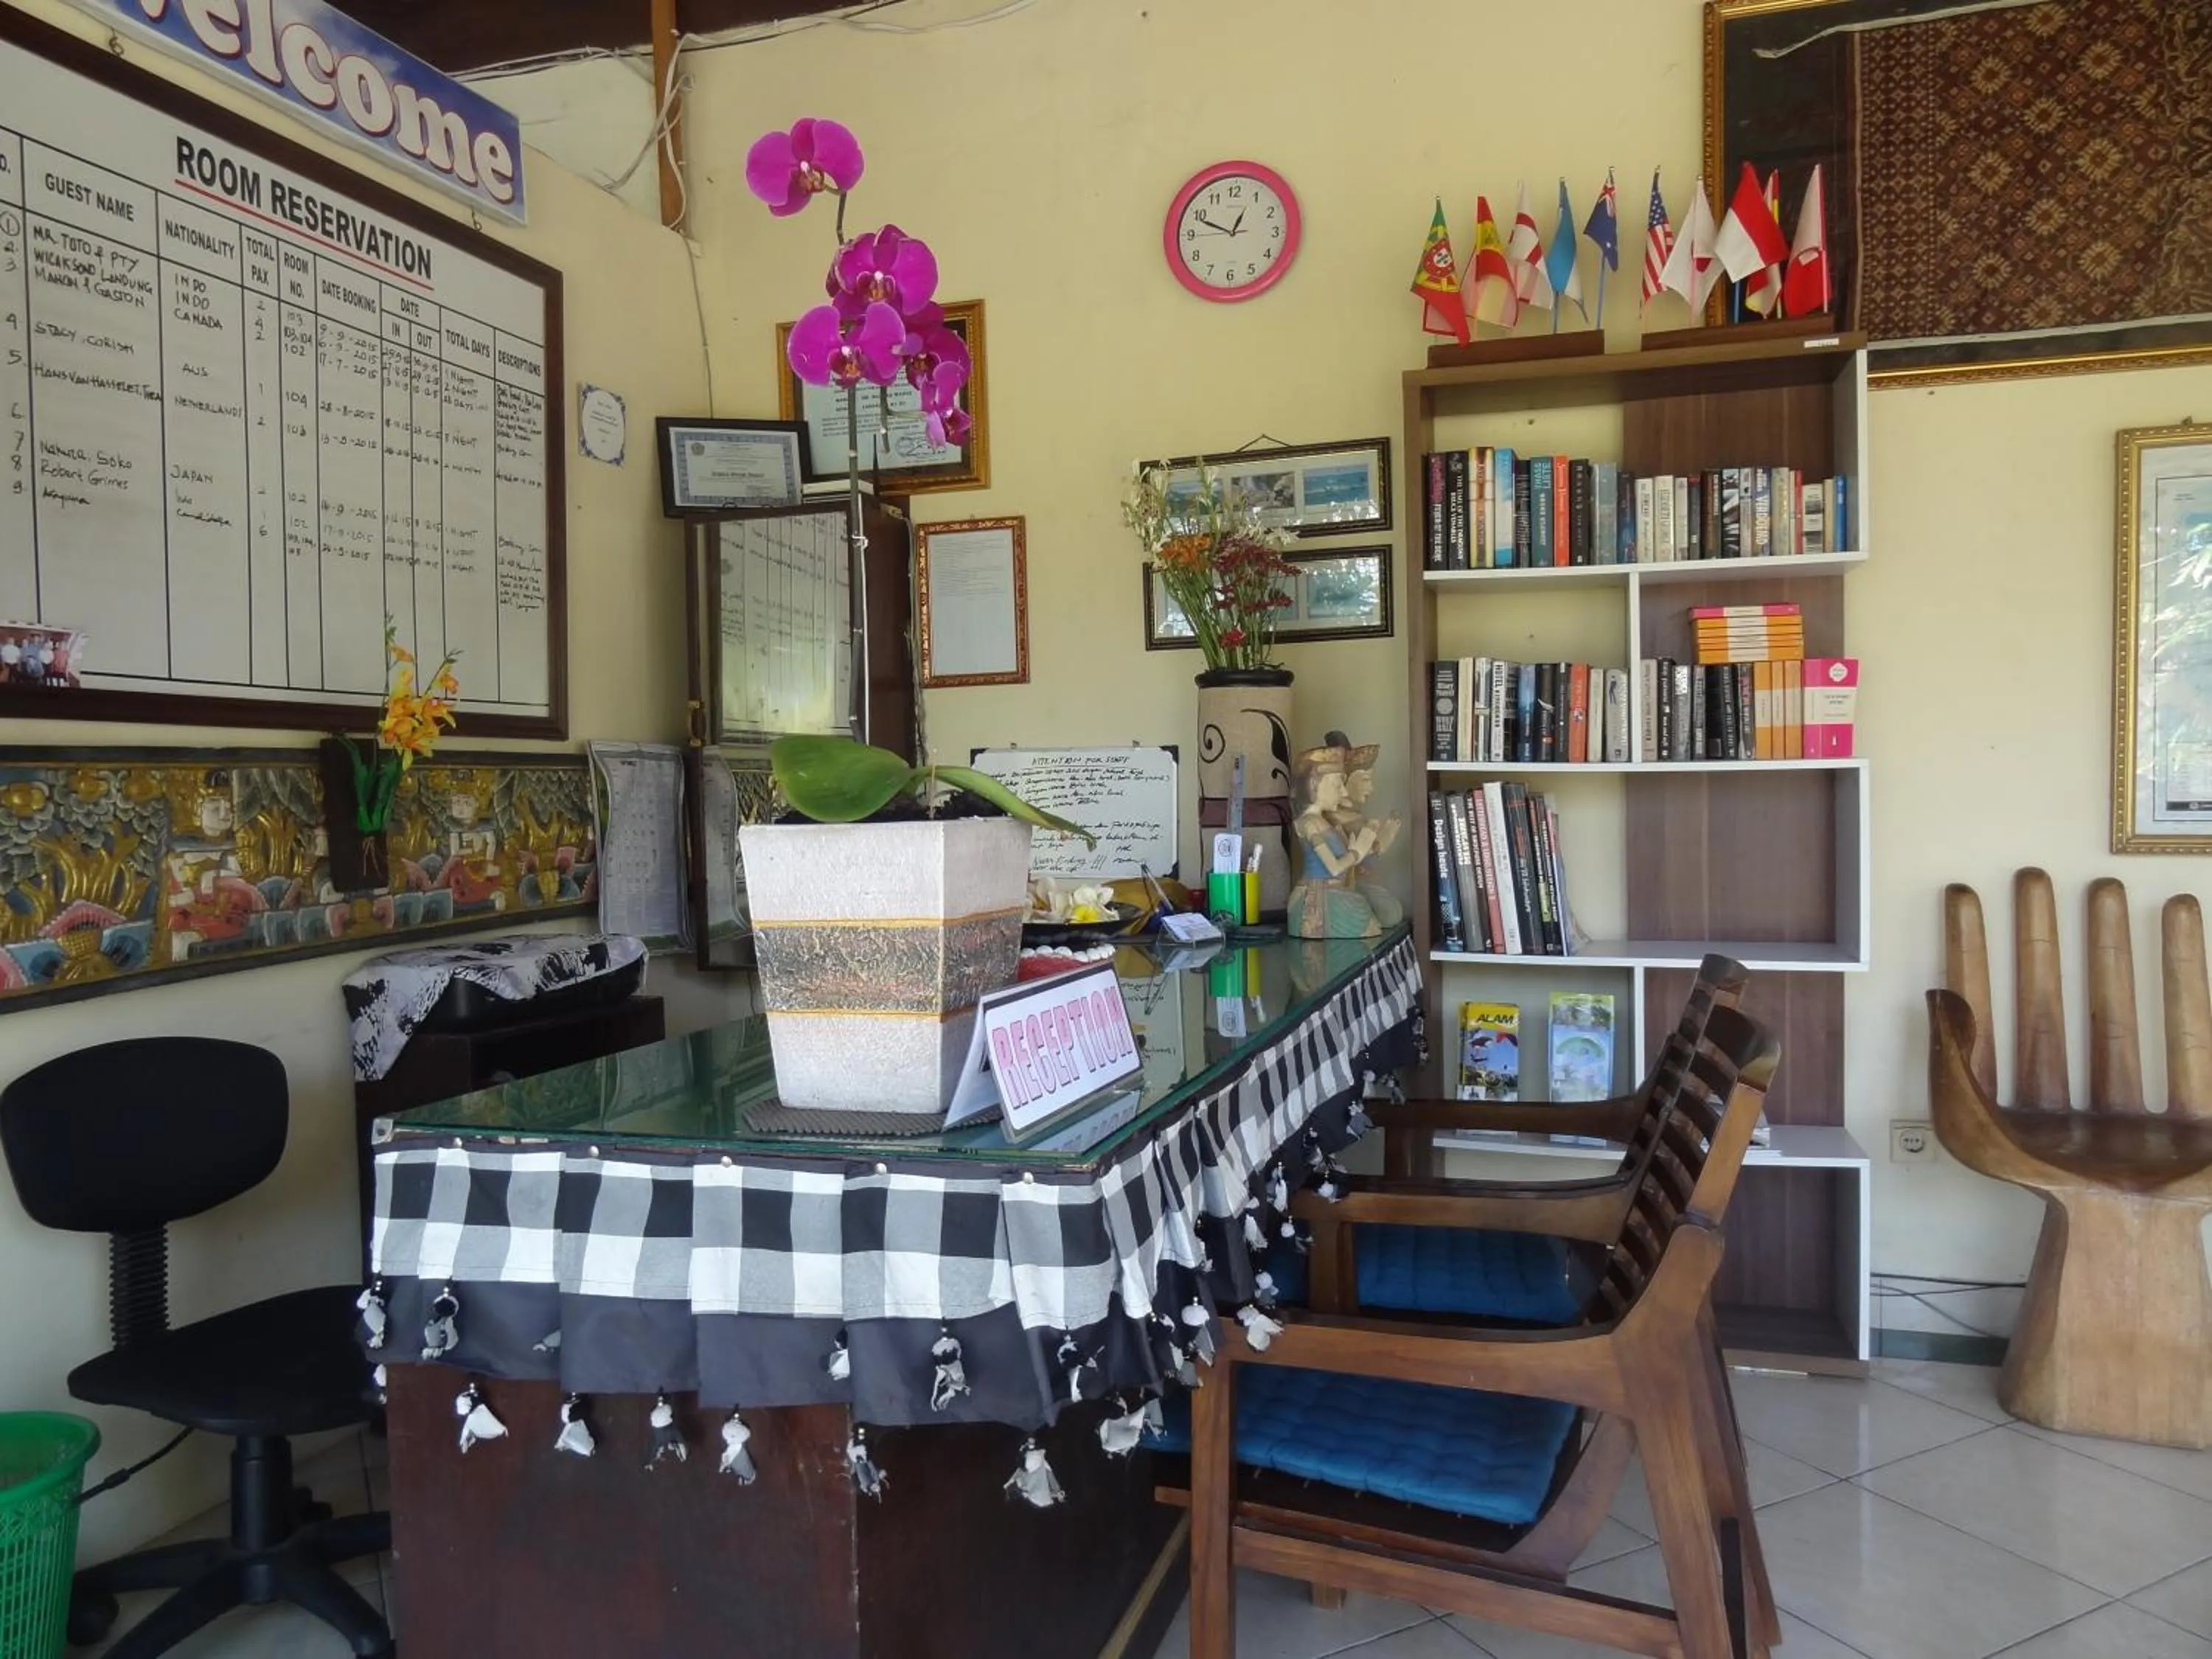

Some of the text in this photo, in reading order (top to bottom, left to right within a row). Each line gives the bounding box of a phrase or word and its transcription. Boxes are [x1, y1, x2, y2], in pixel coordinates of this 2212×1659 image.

[144, 0, 515, 204] elcome
[45, 173, 134, 221] GUEST NAME
[1208, 193, 1220, 205] 11
[1228, 186, 1242, 198] 12
[1253, 192, 1259, 203] 1
[176, 136, 434, 280] ROOM RESERVATION
[1194, 209, 1207, 221] 10
[1267, 206, 1275, 218] 2
[165, 220, 234, 259] NATIONALITY
[1187, 229, 1195, 241] 9
[1272, 226, 1279, 238] 3
[246, 237, 274, 261] TOTAL
[1192, 249, 1200, 261] 8
[1263, 248, 1271, 259] 4
[284, 252, 308, 274] ROOM
[1206, 265, 1214, 276] 7
[1248, 263, 1256, 275] 5
[251, 265, 268, 285] PAX
[1227, 269, 1234, 281] 6
[322, 279, 377, 313] DATE BOOKING
[401, 298, 419, 318] DATE
[174, 308, 223, 330] CANADA
[392, 322, 400, 338] IN
[417, 333, 432, 349] OUT
[445, 330, 490, 358] TOTAL DAYS
[992, 986, 1133, 1110] RECEPTION
